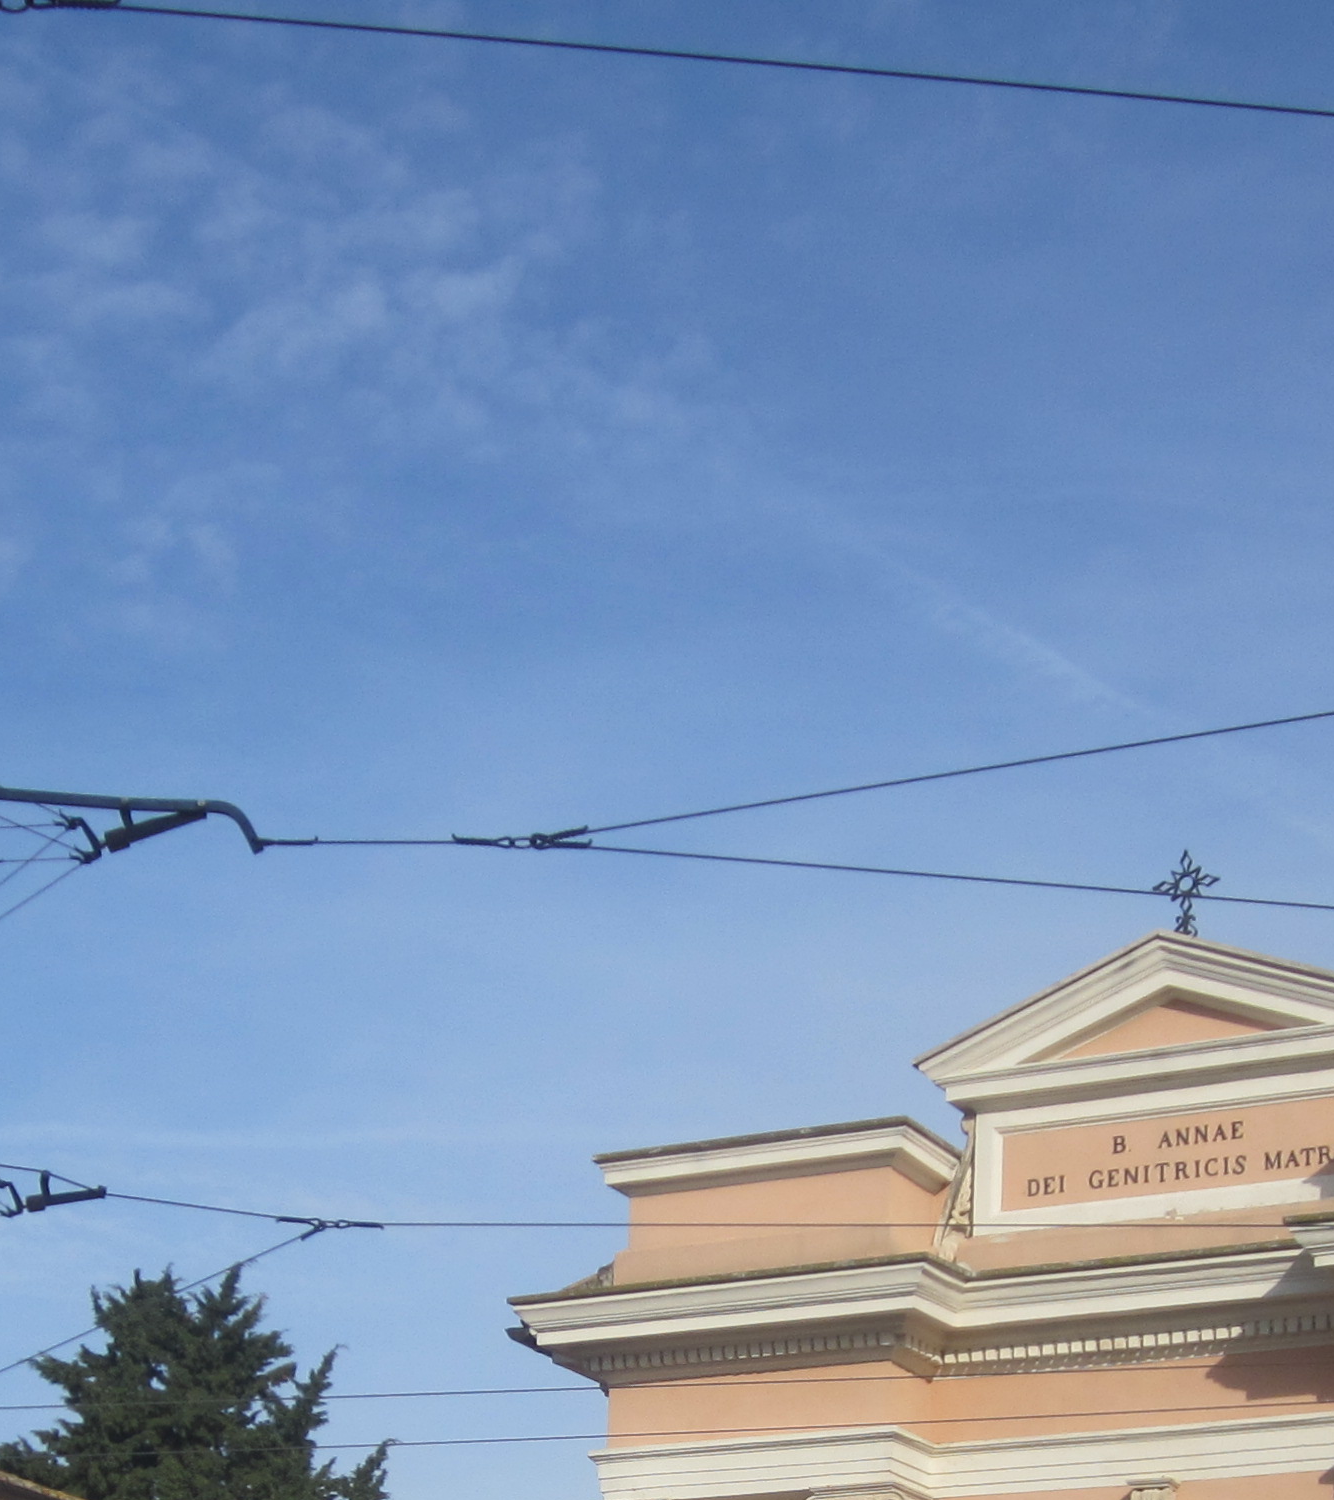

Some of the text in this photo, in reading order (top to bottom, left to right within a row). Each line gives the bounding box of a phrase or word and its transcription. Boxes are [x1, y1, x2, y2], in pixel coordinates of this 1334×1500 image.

[1158, 1121, 1245, 1149] ANNAE
[1027, 1175, 1066, 1197] DEI
[1088, 1155, 1247, 1189] GENITRICIS
